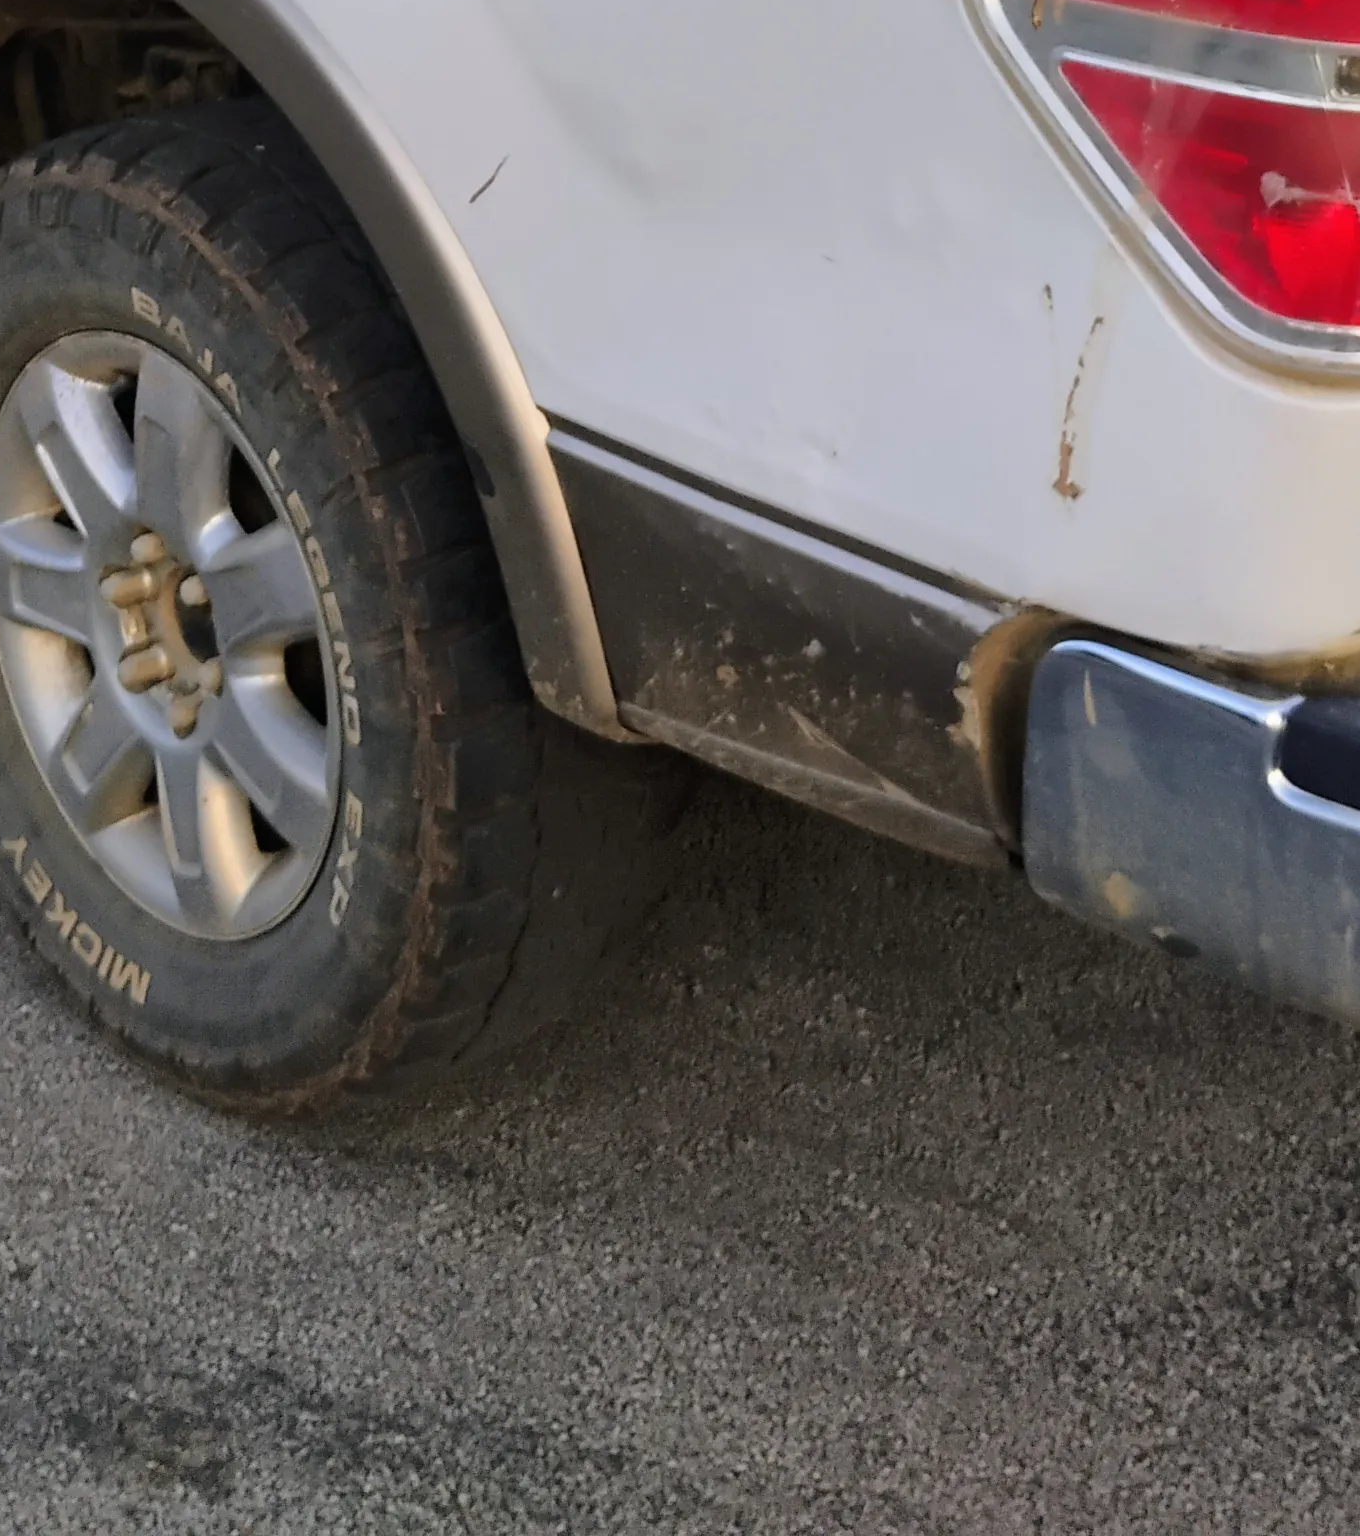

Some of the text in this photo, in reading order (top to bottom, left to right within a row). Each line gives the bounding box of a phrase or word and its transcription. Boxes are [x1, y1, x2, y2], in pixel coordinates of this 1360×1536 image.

[131, 286, 363, 926] BAJA LEGEND EXP
[1, 835, 152, 1007] MICKEY
